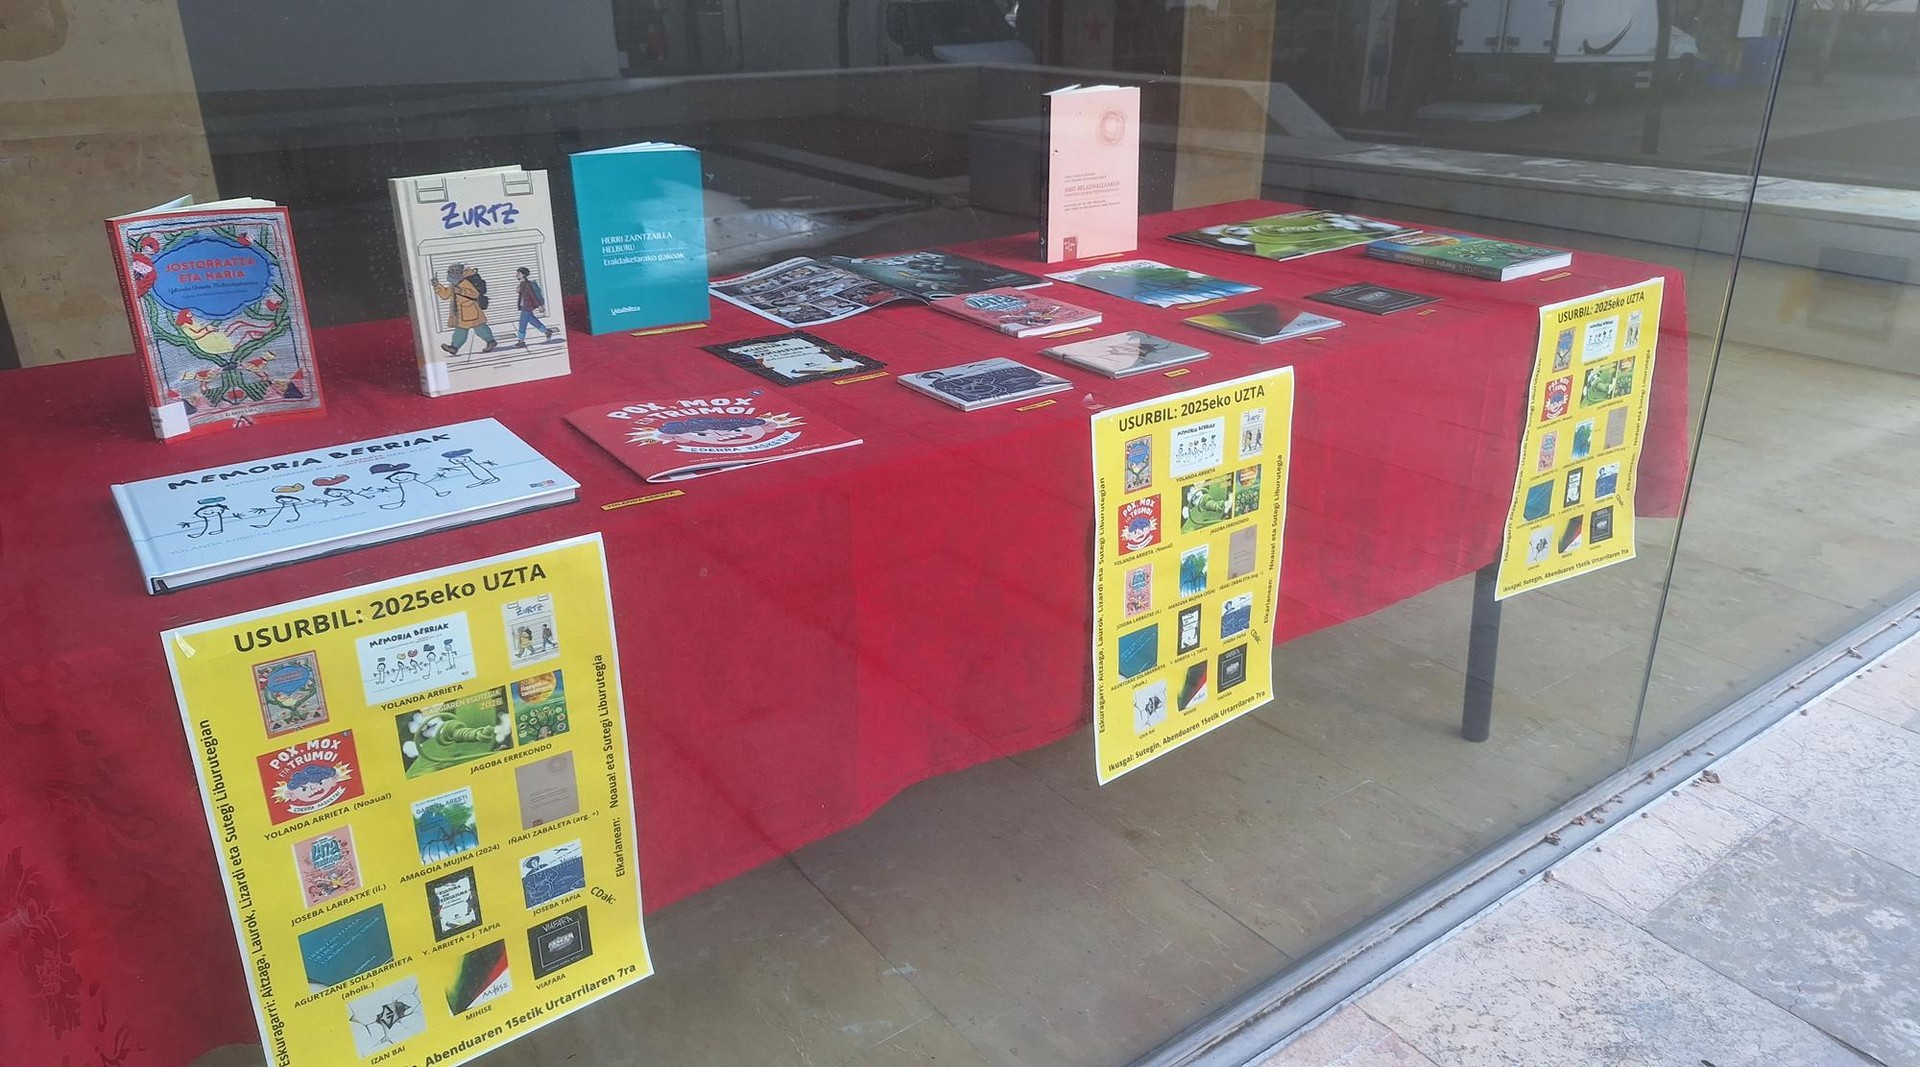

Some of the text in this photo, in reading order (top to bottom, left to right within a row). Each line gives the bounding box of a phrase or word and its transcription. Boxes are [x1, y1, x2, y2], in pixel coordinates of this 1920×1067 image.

[440, 202, 519, 229] ZURTZ
[601, 236, 624, 245] HERRI
[602, 244, 635, 254] HELBURU
[165, 256, 257, 273] JOSTORRATZA
[604, 252, 685, 266] Eraldaketarako gakoak
[179, 270, 246, 284] ETA HARIA
[1558, 291, 1645, 323] USURBIL: 2025eko UZTA
[652, 407, 756, 421] TRUMOI
[677, 397, 753, 407] MOX
[1119, 385, 1265, 431] USURBIL: 2025eko UZTA
[168, 457, 322, 490] MEMORIA
[329, 433, 451, 459] BERRIAK
[1176, 473, 1197, 482] YOLANDA
[1274, 454, 1283, 502] Liburutegia
[1271, 503, 1280, 528] Sutegi
[1098, 537, 1106, 565] Sutegi
[1114, 555, 1136, 566] YOLANDA
[1136, 549, 1154, 560] ARRIETA
[1544, 565, 1575, 579] Abenduaren
[233, 563, 546, 652] USURBIL: 2025eko UZTA
[516, 603, 544, 616] ZURTZ
[369, 622, 450, 648] MEMORIA BERRIAK
[1097, 614, 1105, 647] Laurok,
[1098, 647, 1106, 681] Aitzaga,
[381, 684, 463, 711] YOLANDA ARRIETA
[466, 690, 501, 705] EGUTEGIA
[480, 697, 503, 711] 2026
[1098, 682, 1106, 733] Eskuragarri:
[1108, 690, 1266, 772] Ikusgai: Sutegin, Abenduaren 15etik Urtarrilaren 7ra
[307, 738, 341, 750] MOX
[289, 751, 339, 769] TRUMOI
[470, 743, 552, 775] JAGOBA ERREKONDO
[593, 655, 626, 878] Elkarlanean: Noaua! eta Sutegi Liburutegia
[445, 795, 468, 805] ARESTI
[264, 792, 392, 841] YOLANDA ARRIETA (Noaua!)
[508, 832, 531, 845] IÑAKI
[533, 819, 571, 837] ZABALETA
[572, 814, 590, 826] (arg.
[400, 844, 500, 883] AMAGOIA MUJIKA (2024)
[200, 719, 290, 1067] Eskuragarri: Aitzaga, Laurok, Lizardi eta Sutegi Liburutegian
[291, 884, 387, 927] JOSEBA LARRATXE (il.)
[533, 893, 582, 917] JOSEBA TAPIA
[590, 886, 616, 905] CDak:
[432, 936, 465, 953] ARRIETA
[472, 931, 478, 940] J.
[479, 922, 501, 935] TAPIA
[294, 956, 413, 1008] AGURTZANE SOLABARRIETA
[341, 982, 375, 1000] (aholk.)
[536, 973, 566, 990] VIAFARA
[425, 963, 637, 1067] Abenduaren 15etik Urtarrilaren 7ra
[465, 1005, 492, 1021] MIHISE
[370, 1045, 406, 1065] IZAN BAI
